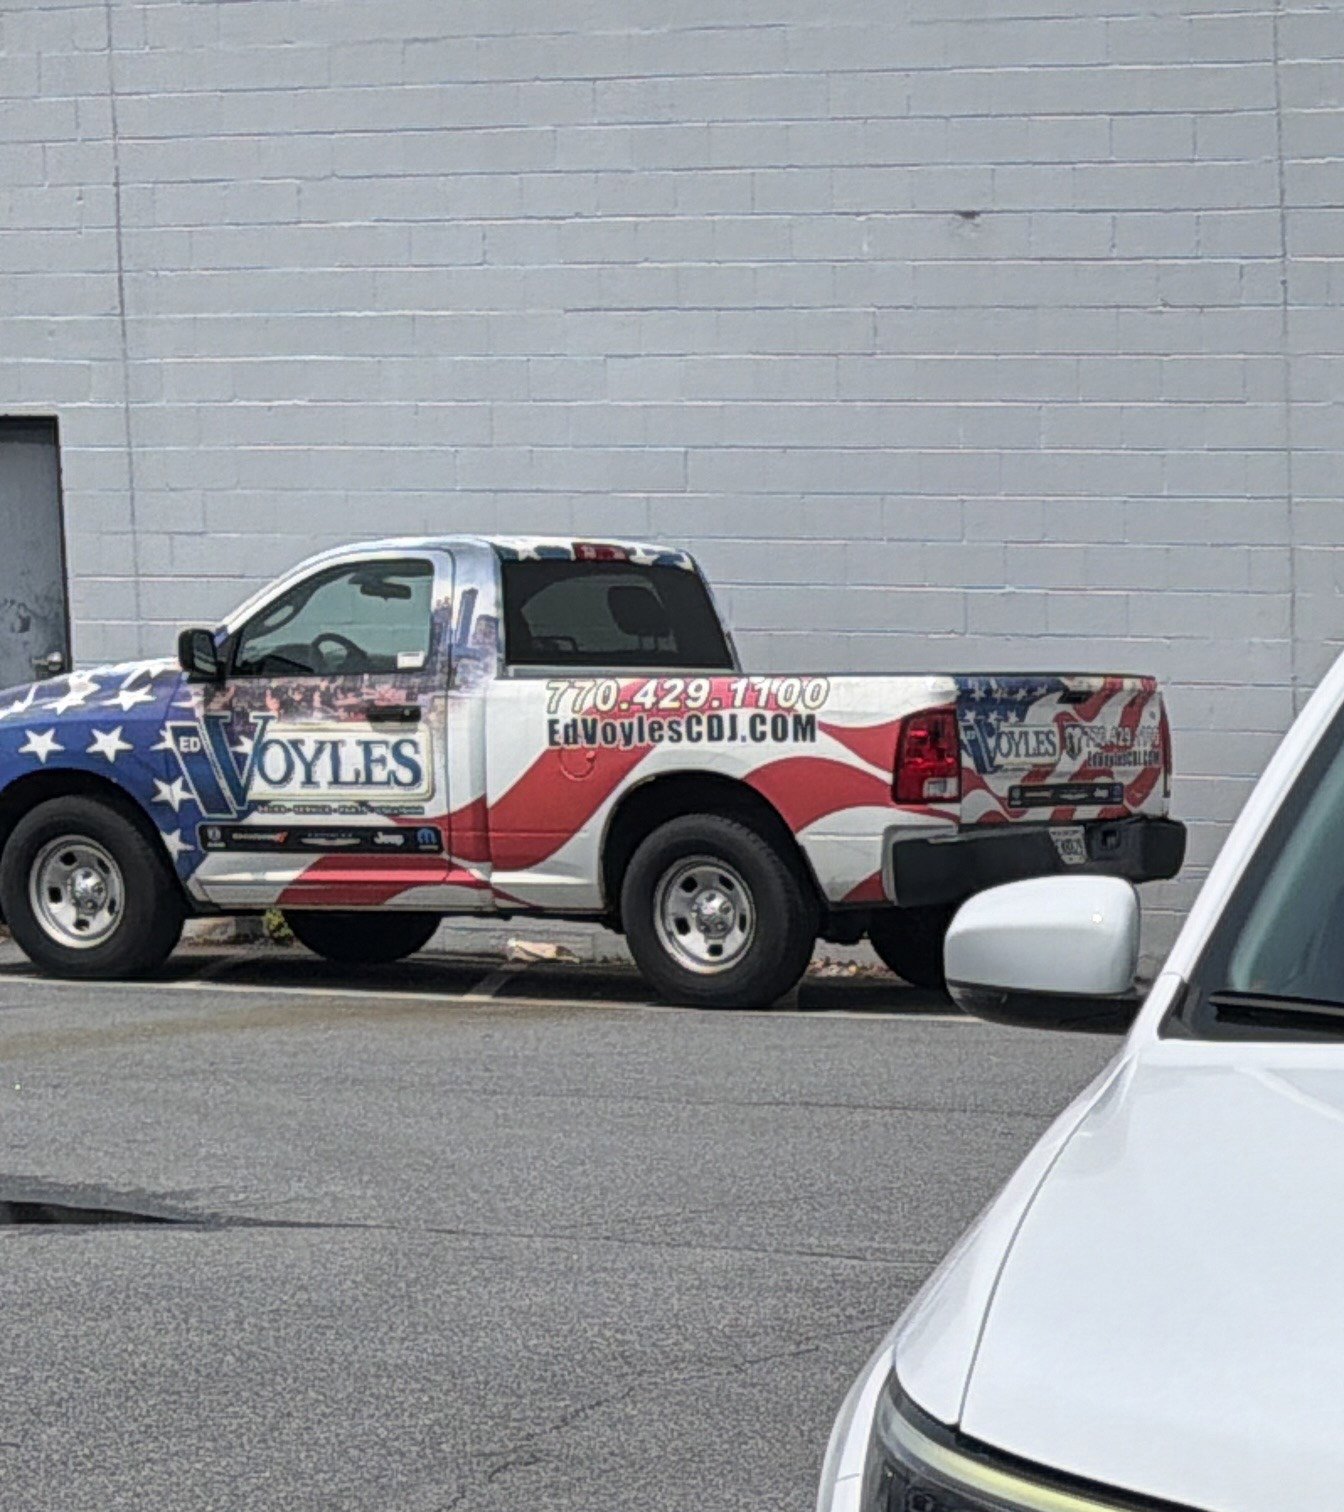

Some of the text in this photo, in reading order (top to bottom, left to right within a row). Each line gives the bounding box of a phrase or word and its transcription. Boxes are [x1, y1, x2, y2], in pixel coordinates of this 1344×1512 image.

[546, 677, 831, 714] 770.429.1100
[179, 736, 199, 752] ED
[547, 713, 817, 747] EdVoylesCDJ.COM
